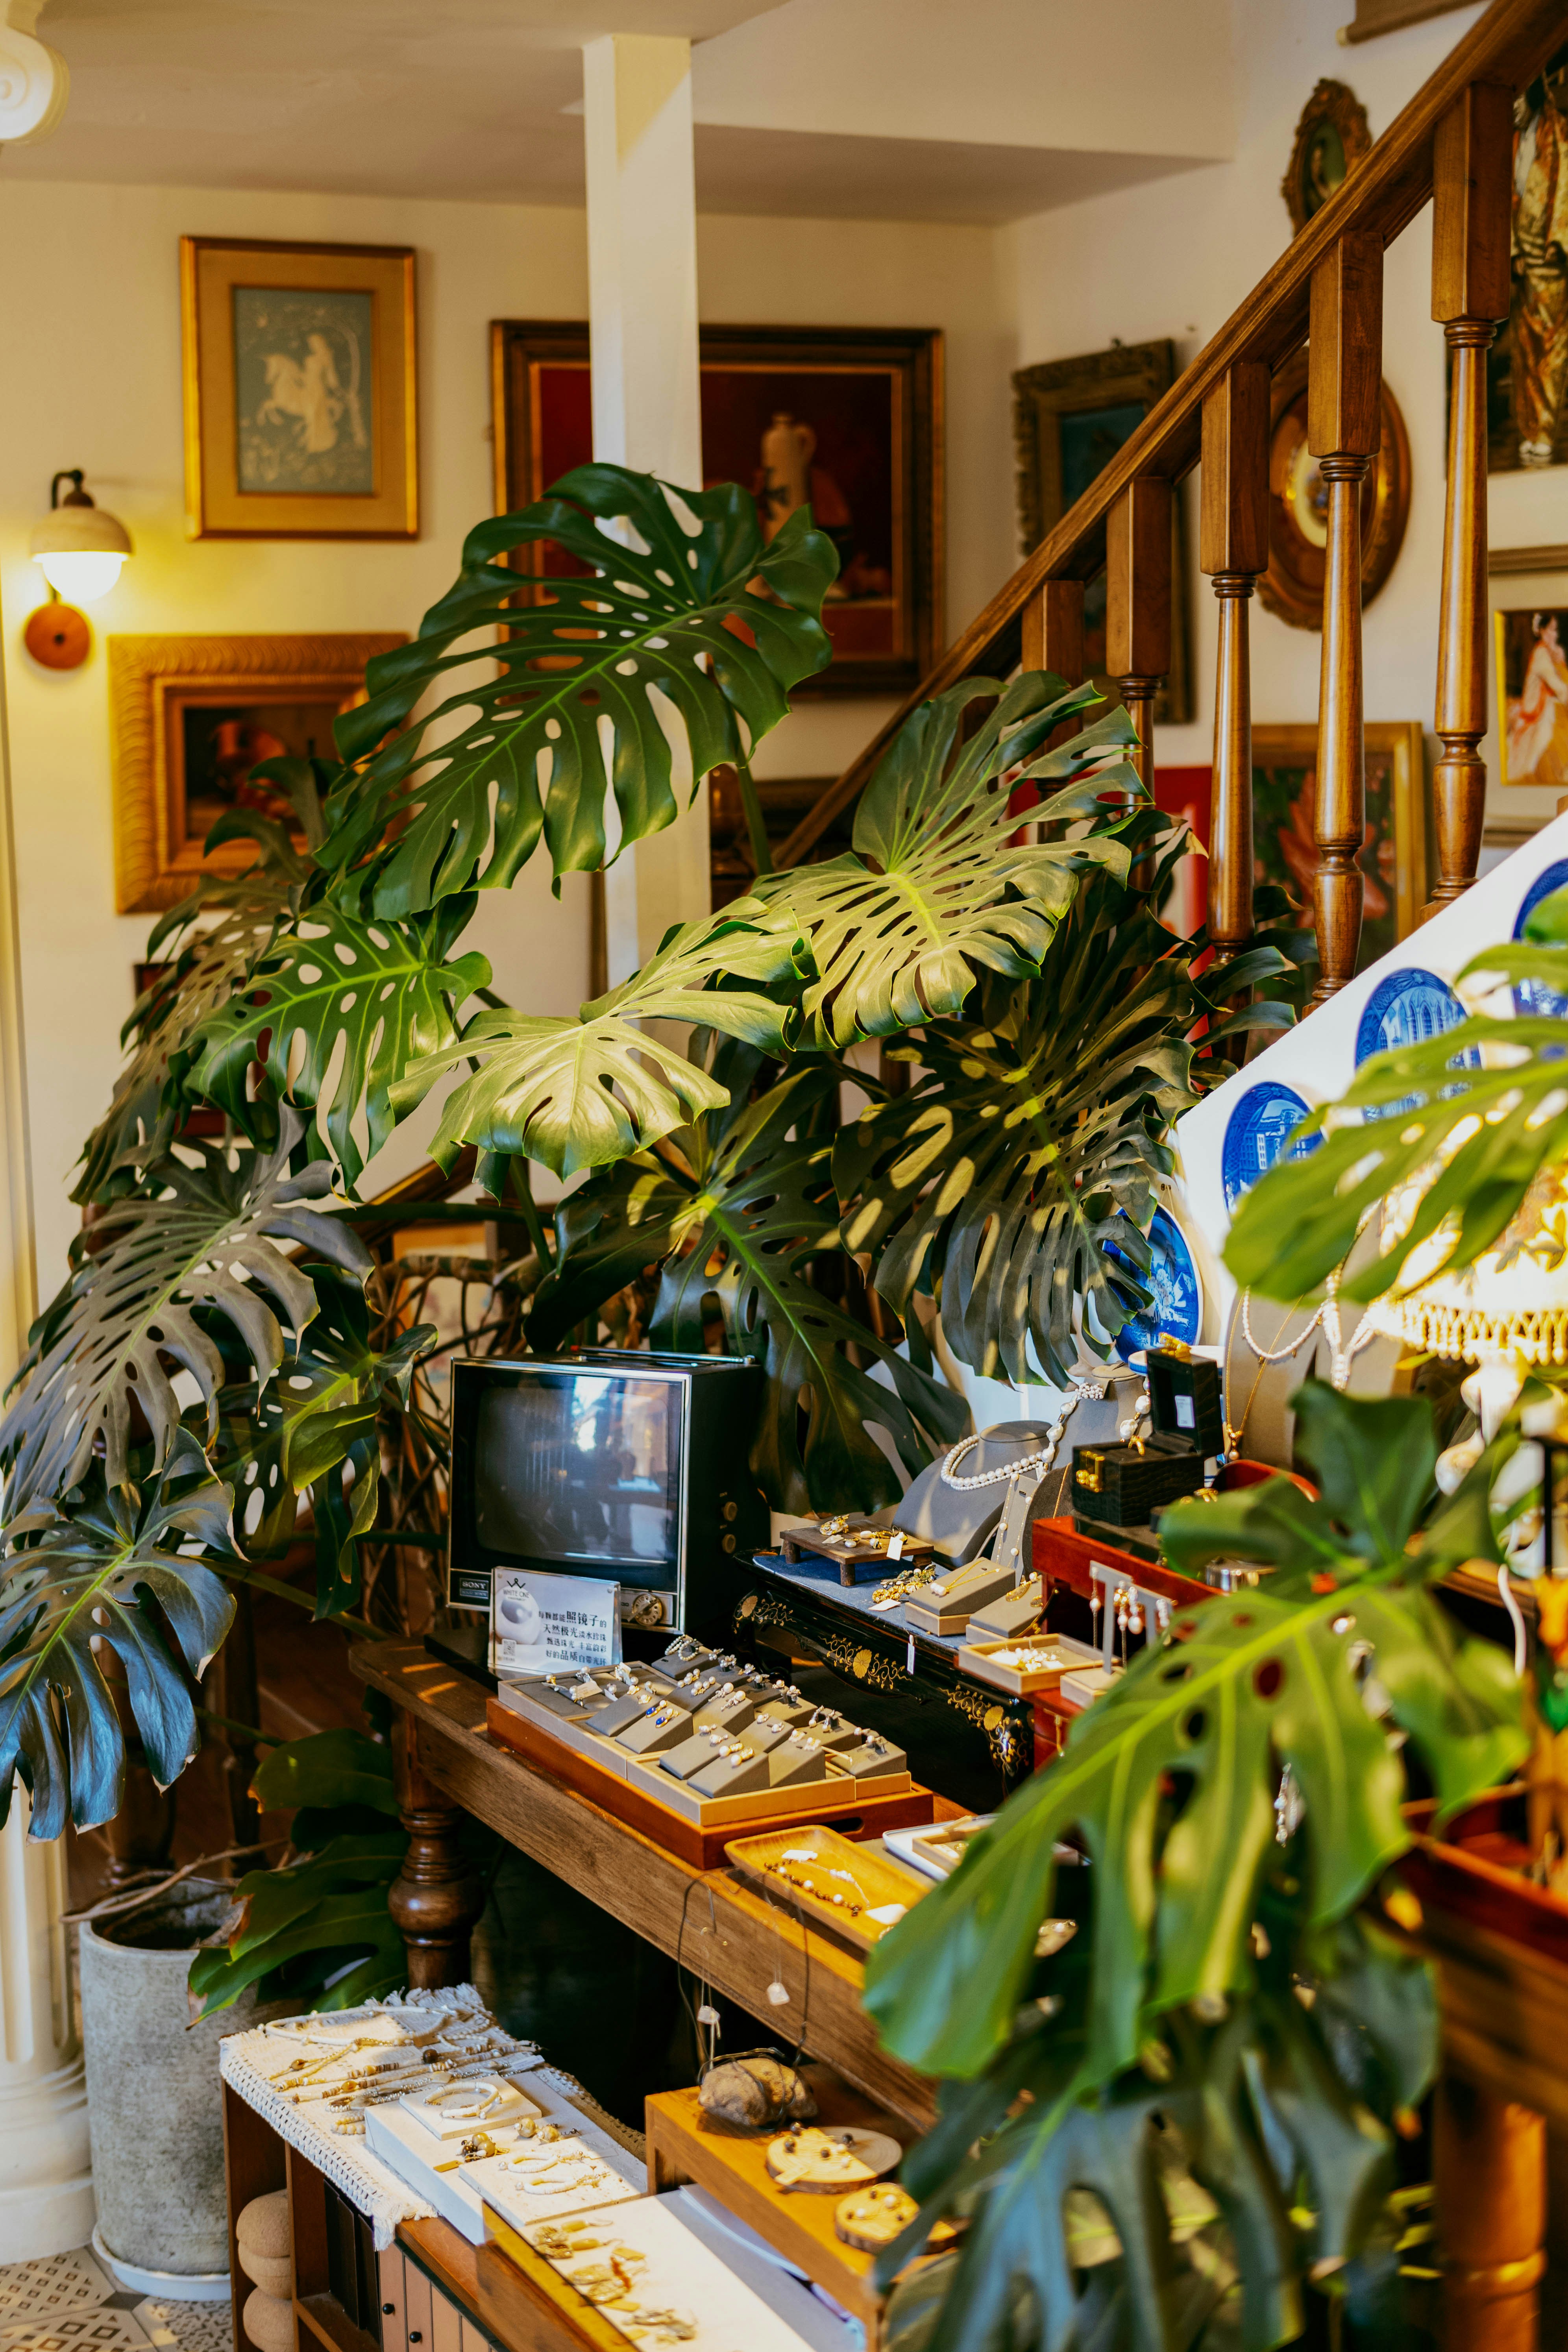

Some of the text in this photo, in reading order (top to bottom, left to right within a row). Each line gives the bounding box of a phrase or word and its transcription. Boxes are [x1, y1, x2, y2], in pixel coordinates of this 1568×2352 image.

[539, 1611, 606, 1628] 每颗都能照镜子的
[543, 1623, 606, 1641] 天然极光淡水珍珠
